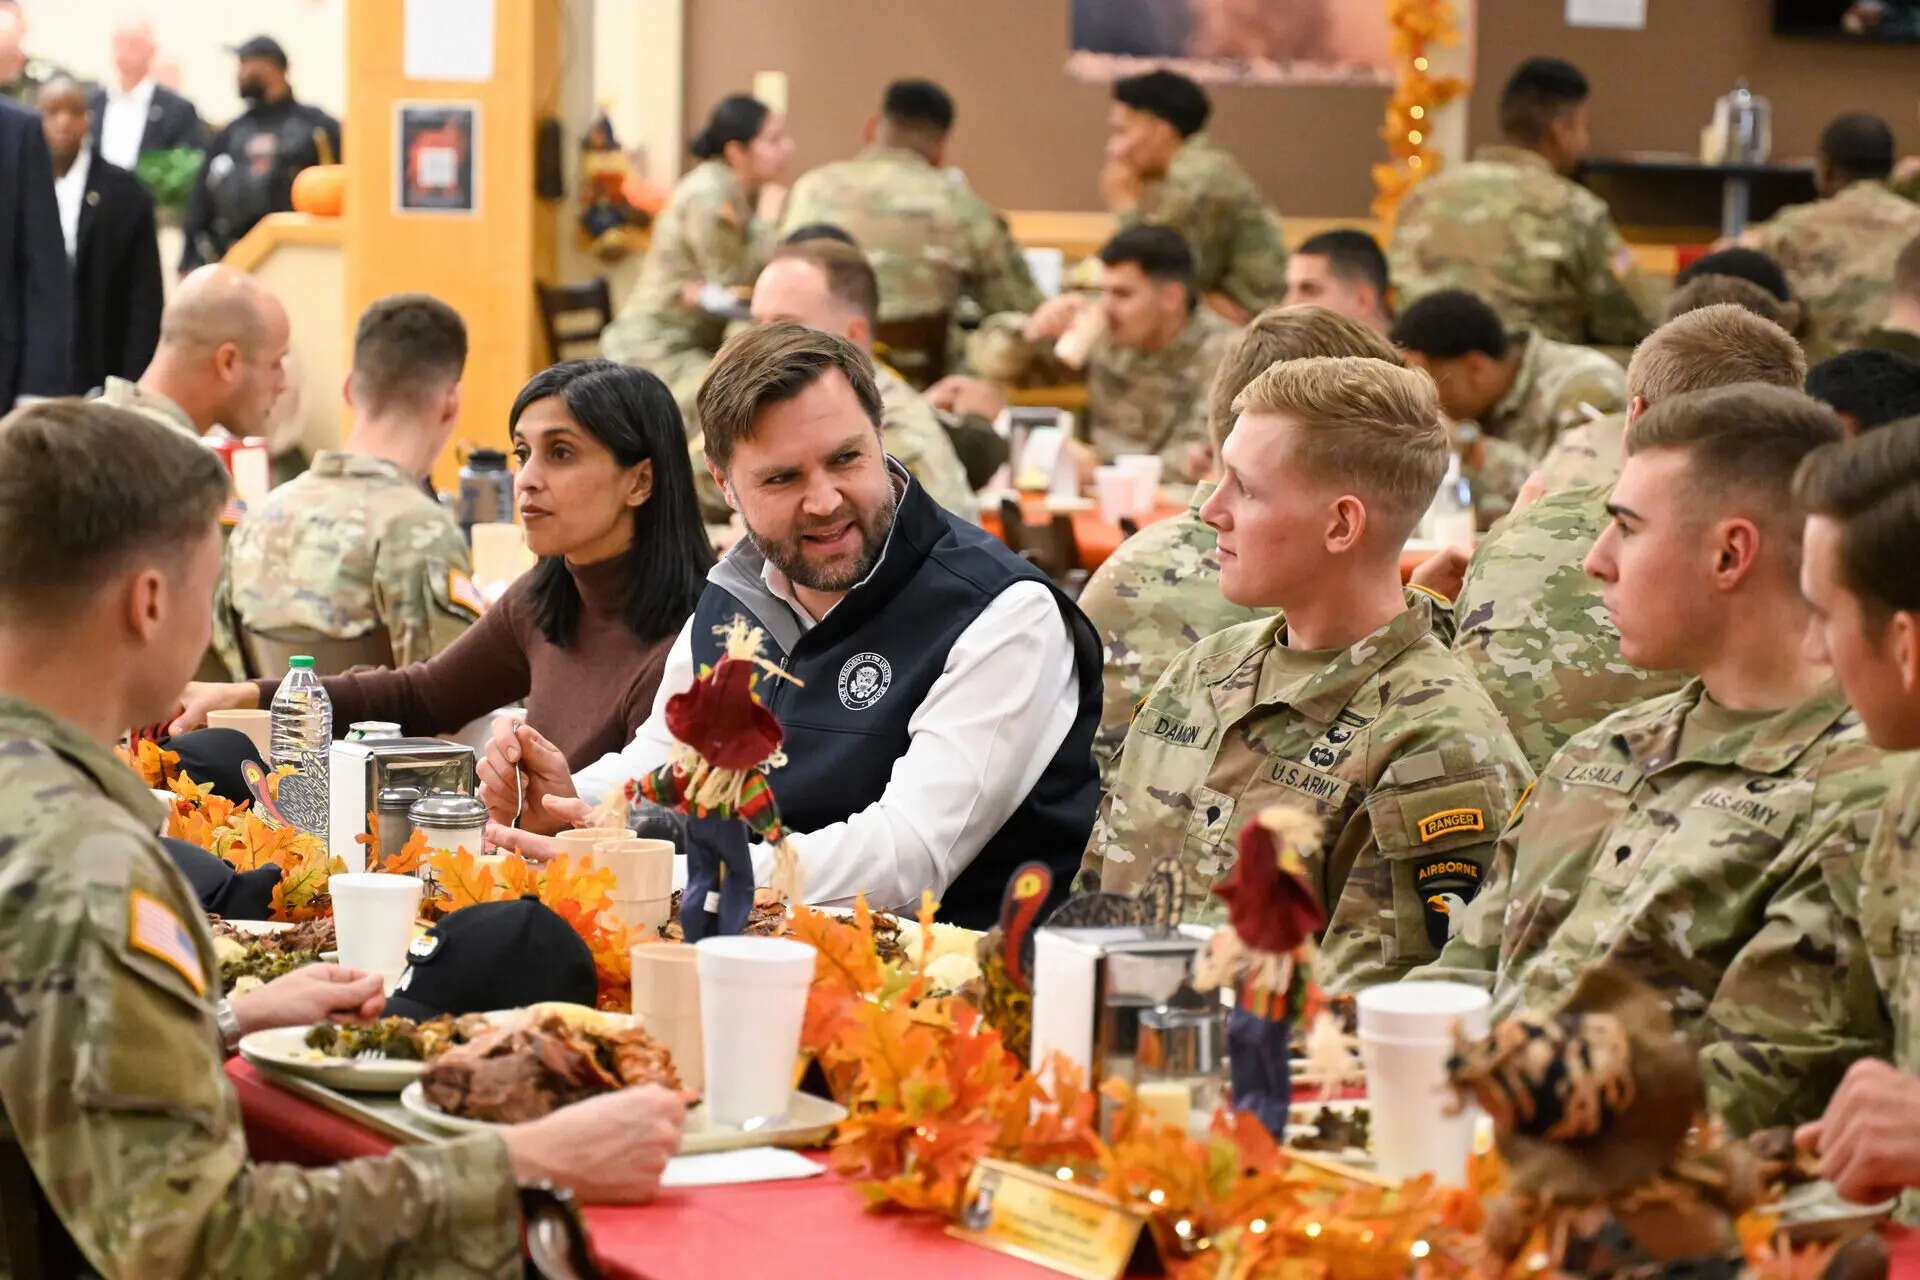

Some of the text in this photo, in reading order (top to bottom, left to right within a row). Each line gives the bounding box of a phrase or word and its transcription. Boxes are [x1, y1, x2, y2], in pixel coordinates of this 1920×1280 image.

[1155, 718, 1201, 744] DAMON
[1428, 814, 1474, 833] RANGER
[1419, 861, 1478, 880] AIRBORNE
